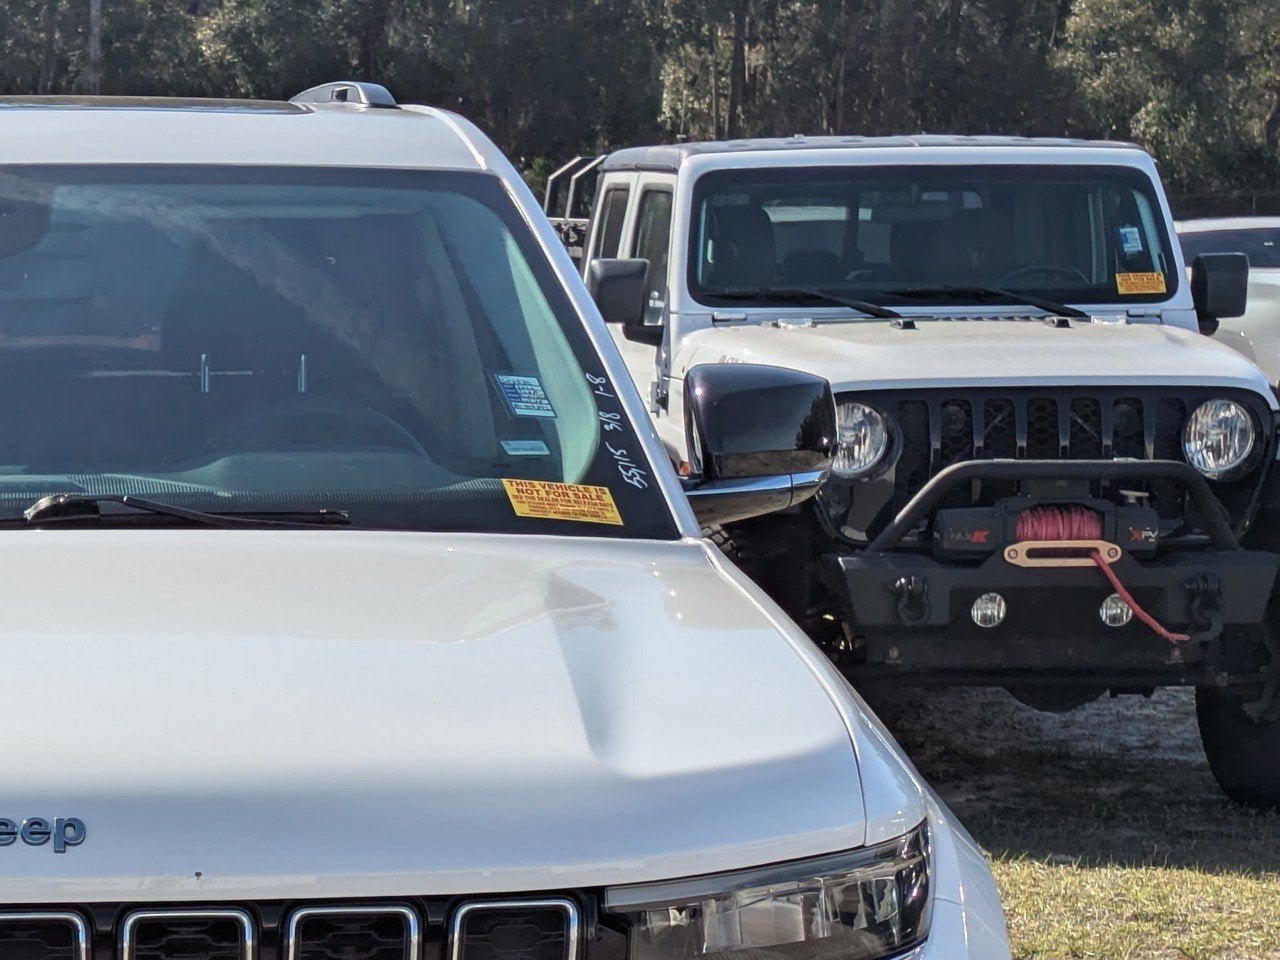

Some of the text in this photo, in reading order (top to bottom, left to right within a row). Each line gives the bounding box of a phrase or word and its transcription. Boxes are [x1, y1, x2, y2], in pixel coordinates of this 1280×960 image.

[506, 480, 607, 495] THIS VEHICLE IS
[515, 488, 605, 501] NOT FOR SALE
